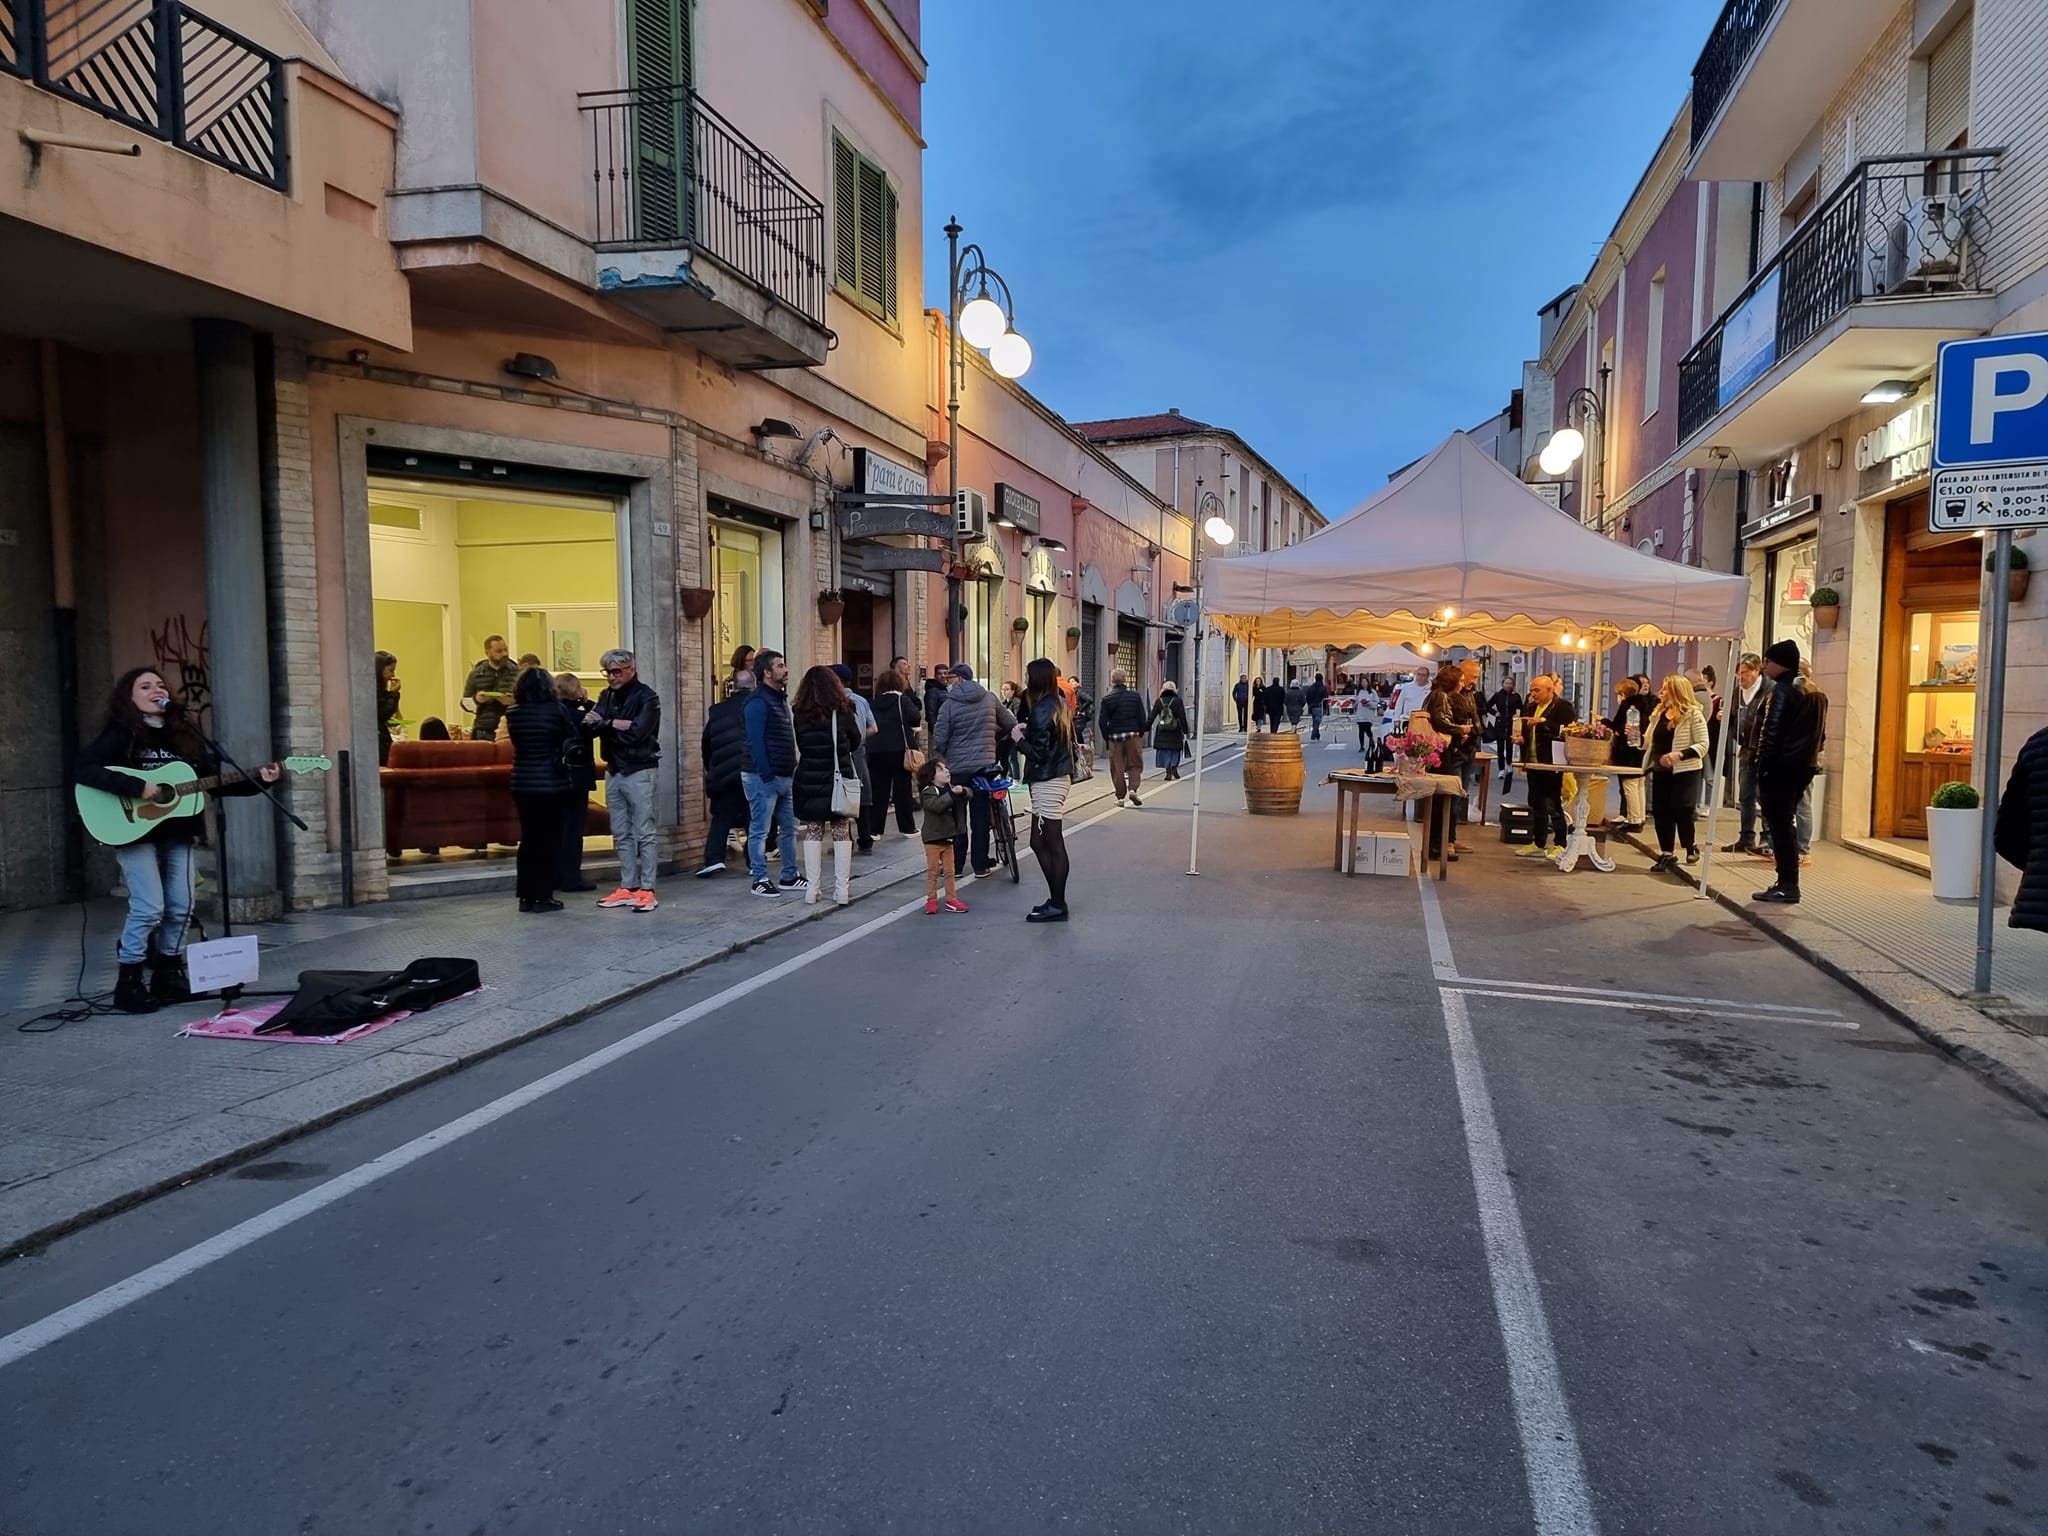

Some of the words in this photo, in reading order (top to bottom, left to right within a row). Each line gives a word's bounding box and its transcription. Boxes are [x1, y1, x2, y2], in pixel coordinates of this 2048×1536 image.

[1970, 353, 2048, 445] P
[872, 463, 896, 491] pani
[1960, 475, 1970, 483] AD
[1973, 474, 1989, 482] ALTA
